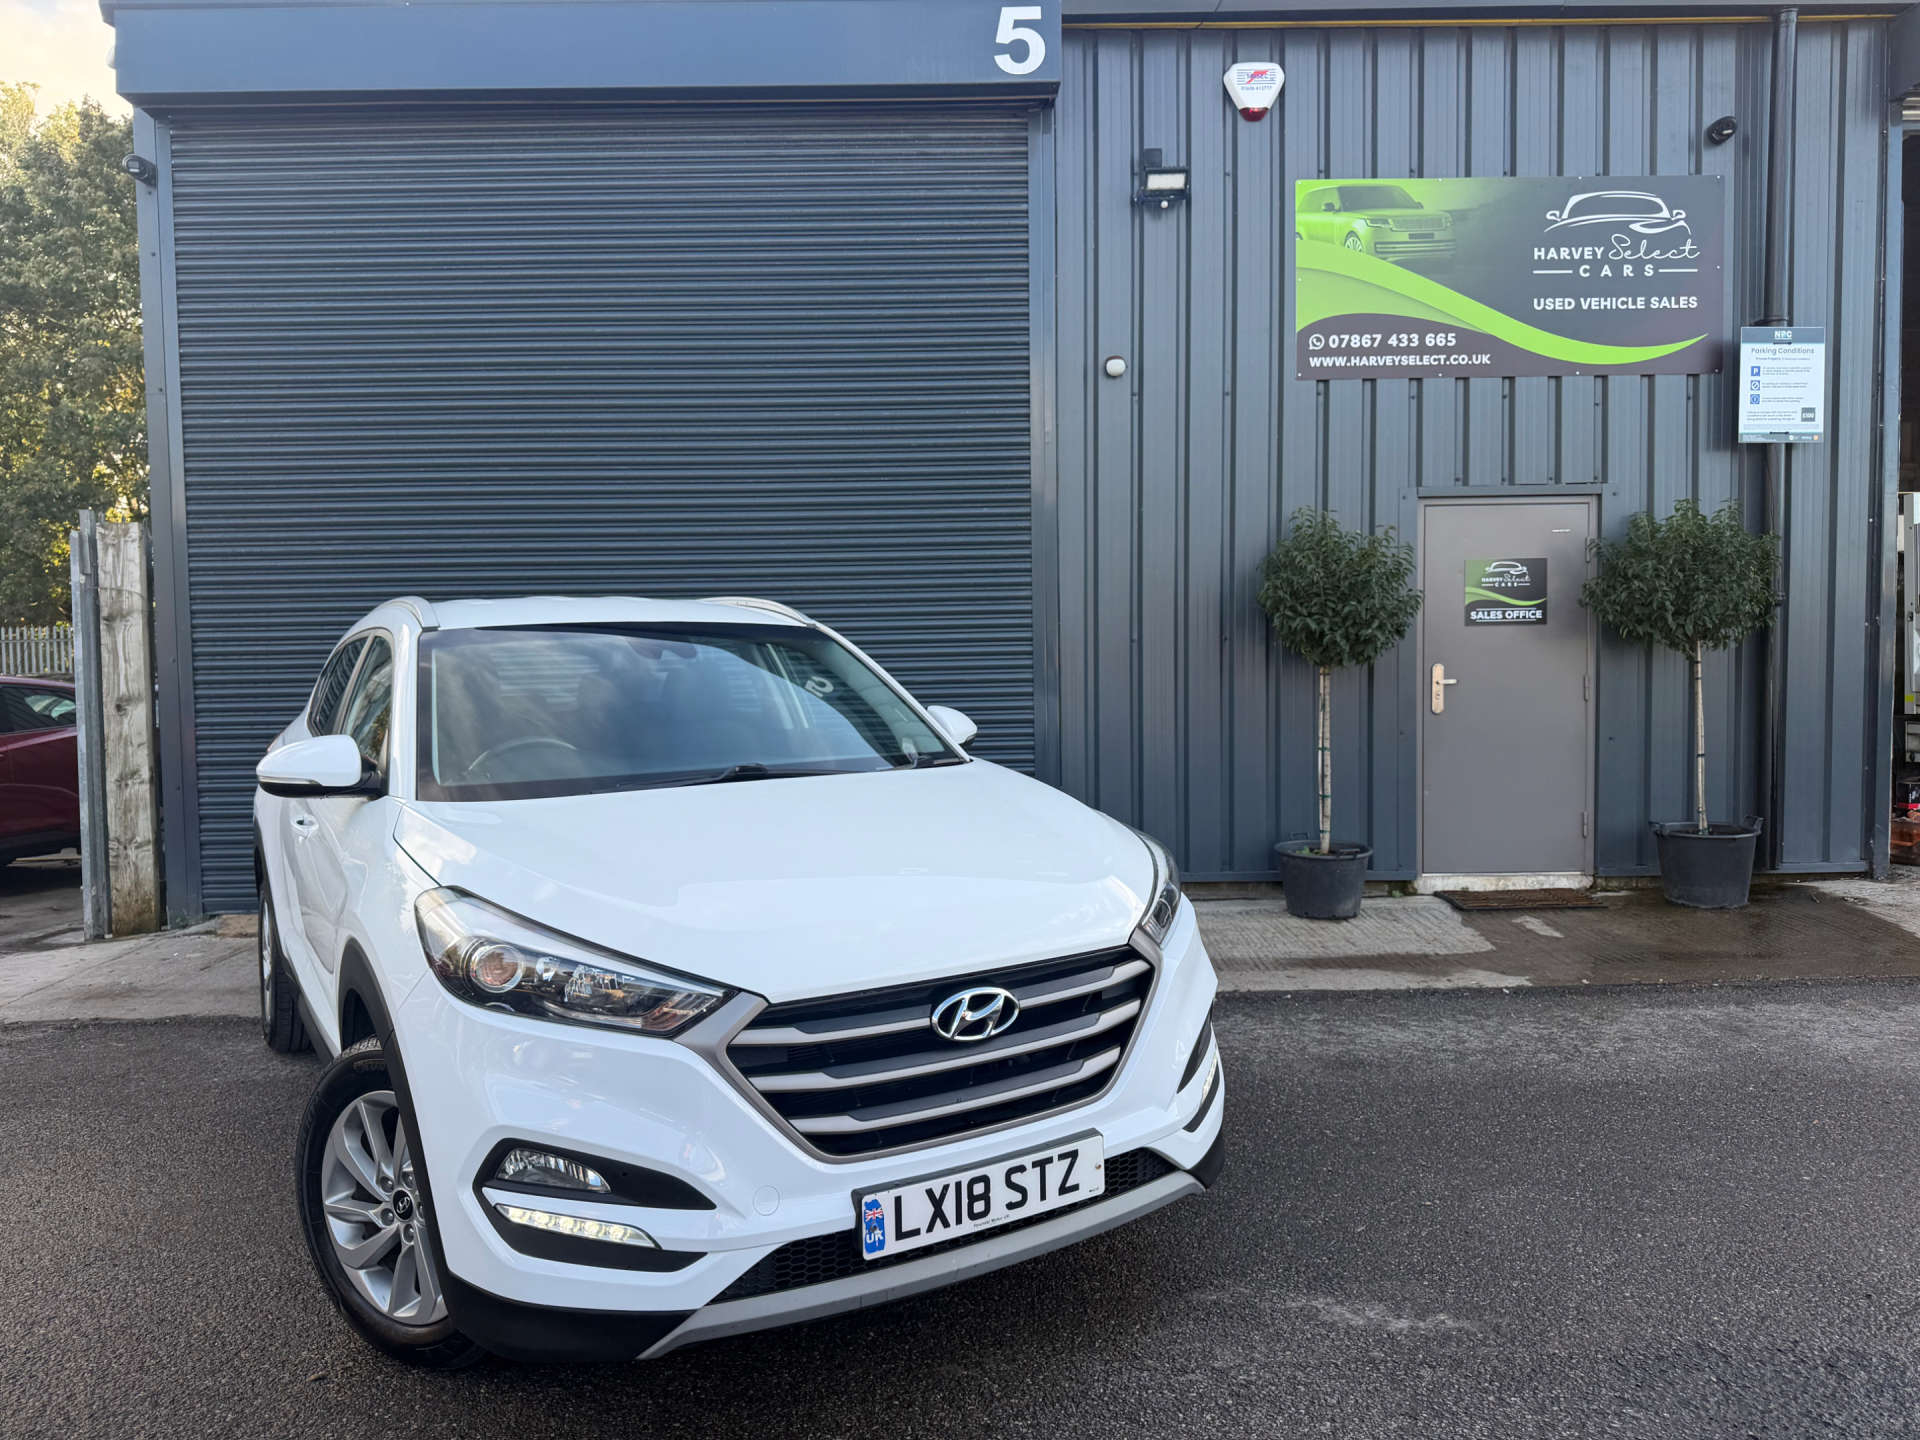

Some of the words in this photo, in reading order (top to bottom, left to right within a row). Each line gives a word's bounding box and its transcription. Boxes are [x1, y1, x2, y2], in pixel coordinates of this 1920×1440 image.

[993, 6, 1046, 75] 5
[1533, 246, 1604, 261] HARVEY
[1608, 233, 1700, 261] Select
[1579, 263, 1655, 278] CARS
[1533, 297, 1575, 311] USED
[1580, 296, 1646, 310] VEHICLE
[1650, 296, 1698, 309] SALES
[1328, 333, 1382, 349] 07867
[1387, 333, 1420, 348] 433
[1425, 332, 1457, 347] 665
[1751, 346, 1777, 355] Parking
[1778, 346, 1815, 355] Conditions
[1309, 353, 1491, 368] WWW.HARVEYSELECT.CO.UK
[1470, 610, 1503, 620] SALES
[1505, 610, 1543, 619] OFFICE
[893, 1174, 991, 1241] LX18
[1005, 1148, 1080, 1211] STZ
